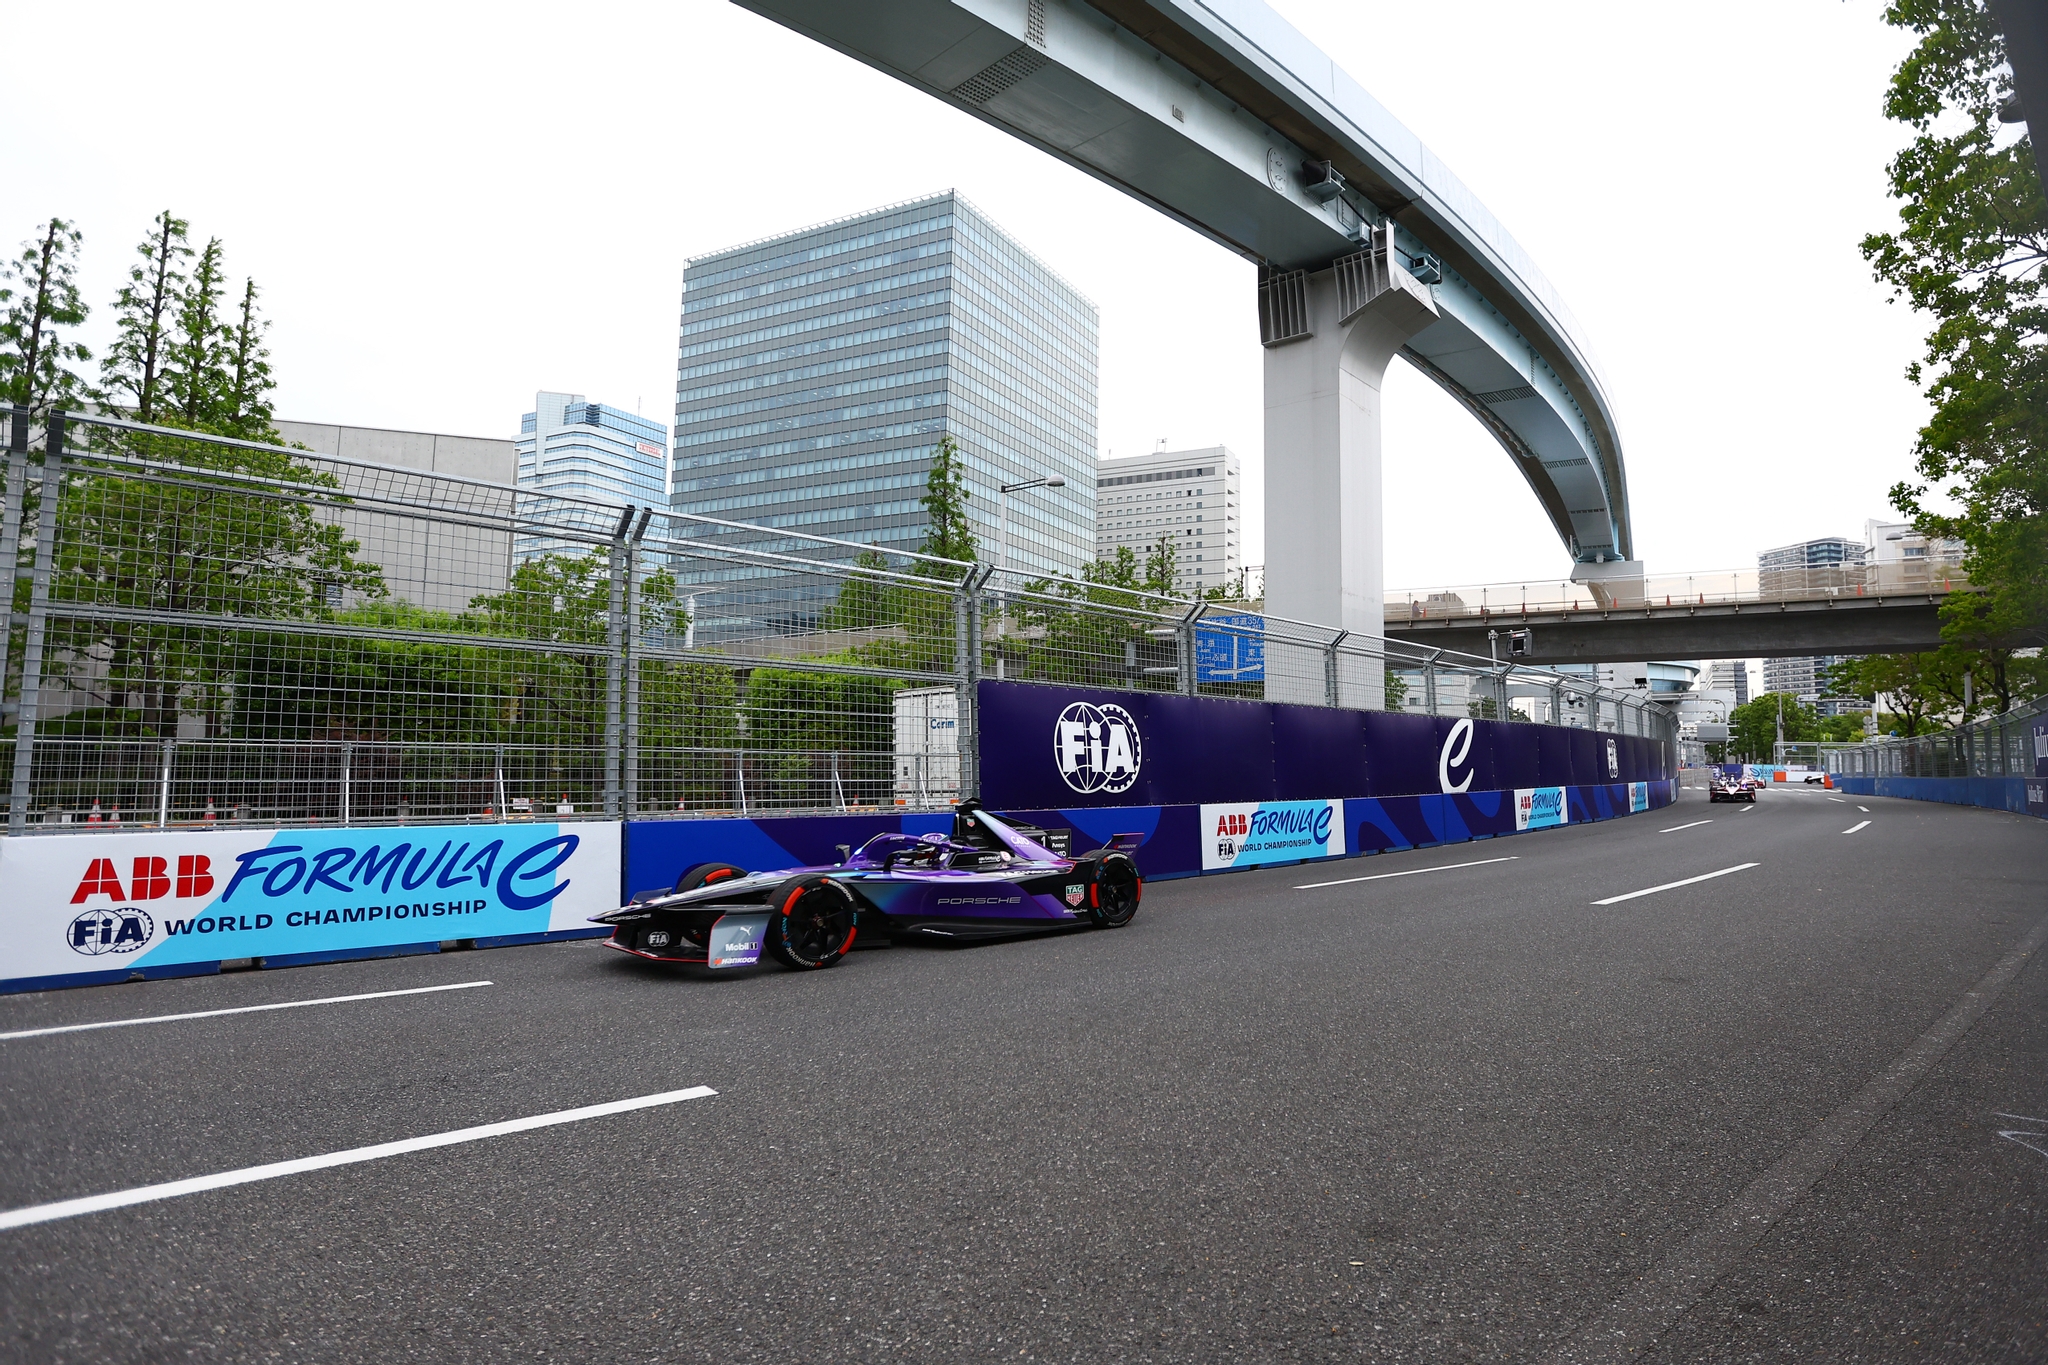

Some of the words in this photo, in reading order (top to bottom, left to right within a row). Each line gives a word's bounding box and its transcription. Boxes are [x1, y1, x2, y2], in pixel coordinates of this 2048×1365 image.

[1217, 814, 1247, 836] ABB
[1249, 808, 1314, 837] FORMULA
[1237, 844, 1262, 853] WORLD
[1263, 839, 1312, 851] CHAMPIONSHIP
[70, 855, 214, 904] ABB
[221, 839, 503, 903] FORMULA
[938, 897, 1021, 905] PORSCHE
[165, 914, 273, 936] WORLD
[286, 900, 487, 927] CHAMPIONSHIP
[605, 913, 651, 922] PORSCHE
[725, 943, 749, 952] Mobil
